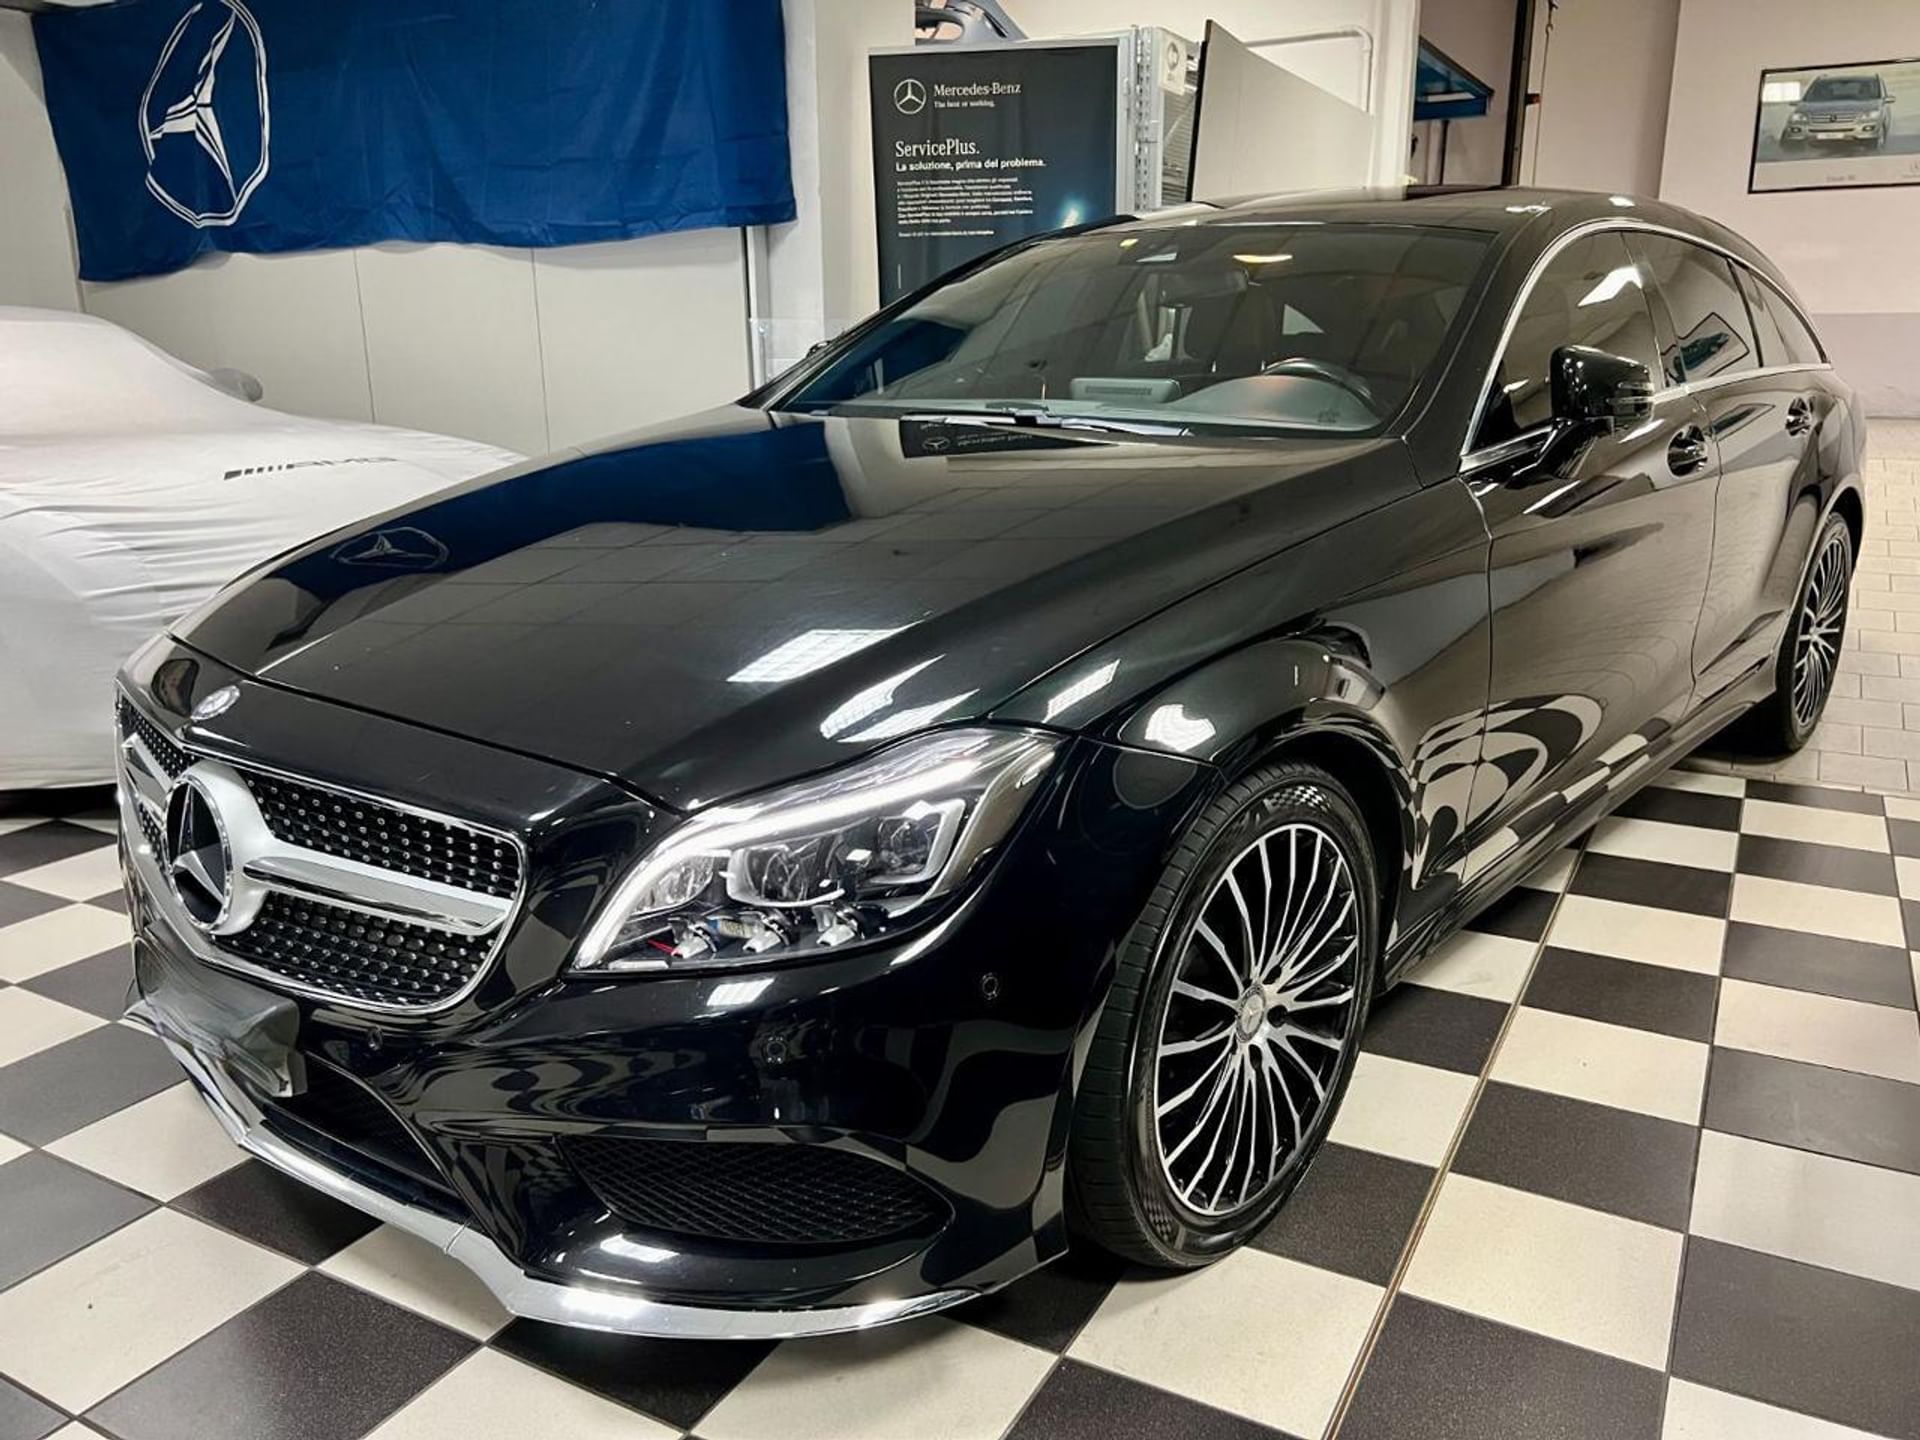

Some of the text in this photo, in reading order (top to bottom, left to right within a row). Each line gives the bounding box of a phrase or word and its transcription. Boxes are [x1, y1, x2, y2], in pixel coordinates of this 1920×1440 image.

[934, 82, 1021, 97] Mercedes-Benz
[895, 138, 980, 157] ServicePlus.
[895, 157, 1047, 172] La soluzione, prima del problema.
